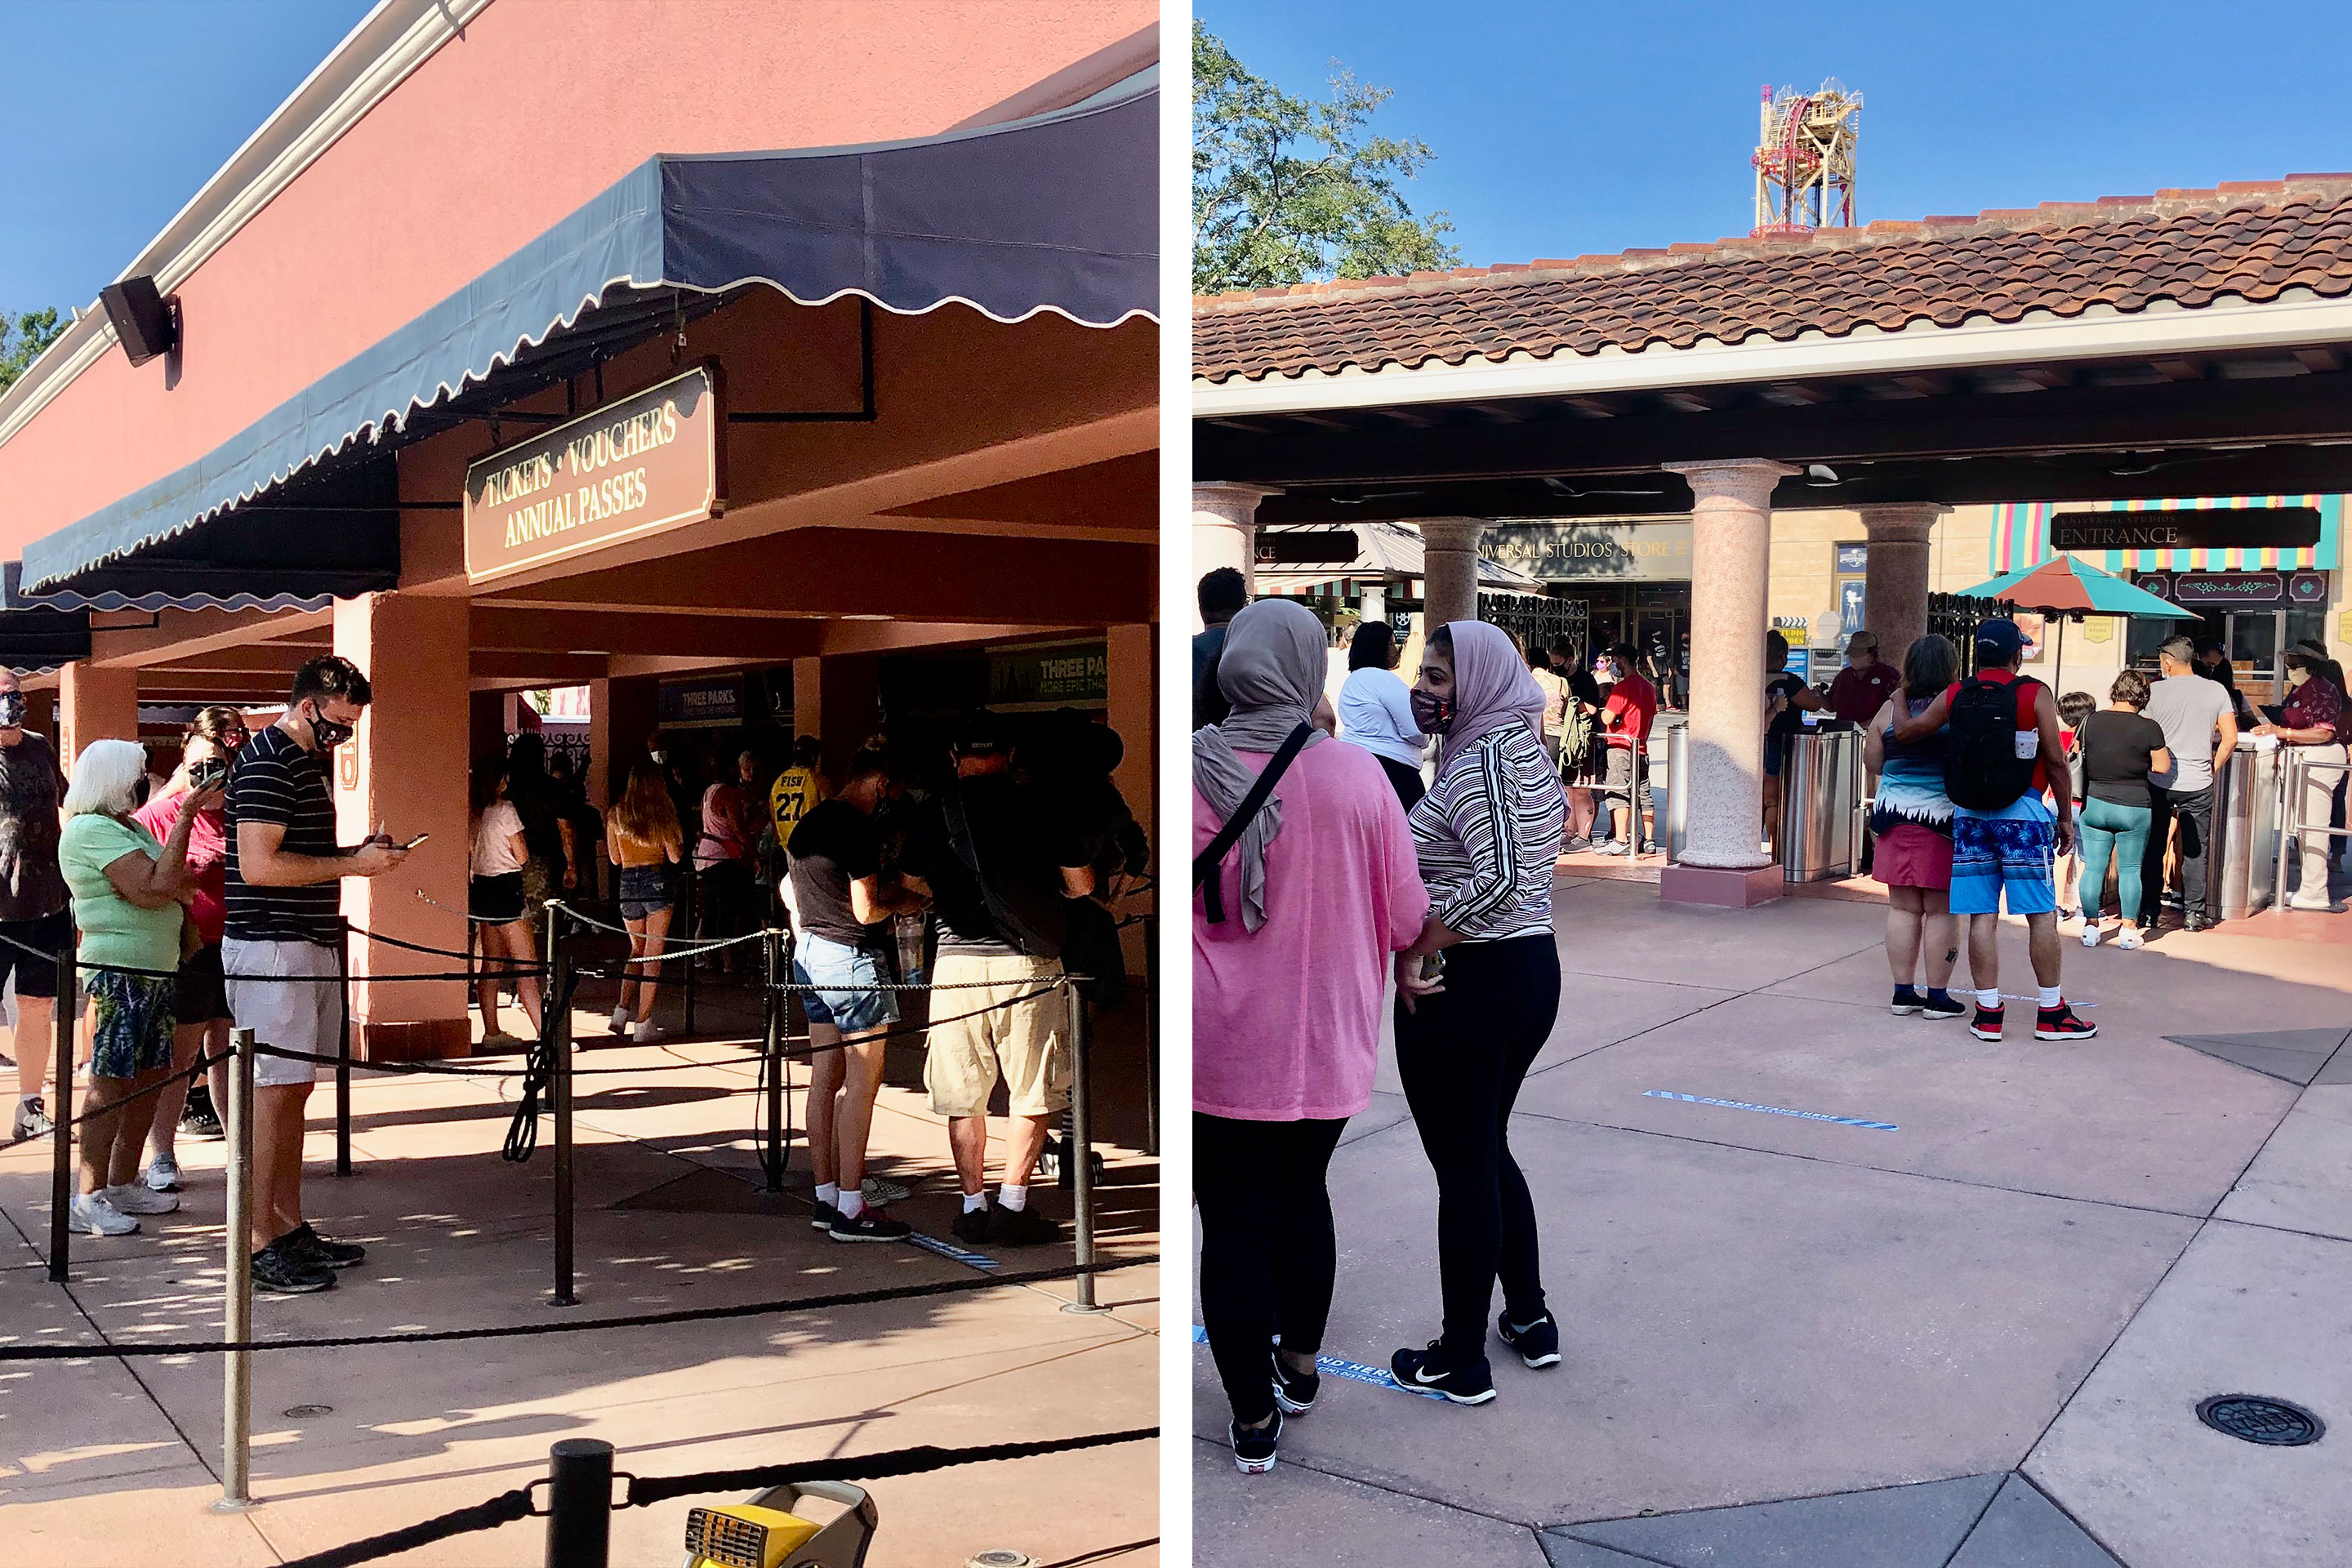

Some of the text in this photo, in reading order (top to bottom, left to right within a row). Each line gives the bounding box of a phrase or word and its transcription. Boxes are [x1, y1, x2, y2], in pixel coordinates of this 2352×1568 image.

[486, 400, 677, 508] TICKETS VOUCHERS
[504, 467, 647, 549] ANNUAL PASSES
[2059, 527, 2178, 545] ENTRANCE
[1477, 541, 1671, 559] NIVERSAL STUDIOS STORE
[1040, 655, 1106, 679] THREE PA
[1040, 678, 1107, 693] MORE EPIC THA
[683, 691, 707, 706] THREE
[781, 776, 804, 787] FISH
[776, 792, 804, 822] 27
[1340, 1370, 1388, 1386] DISTANCE
